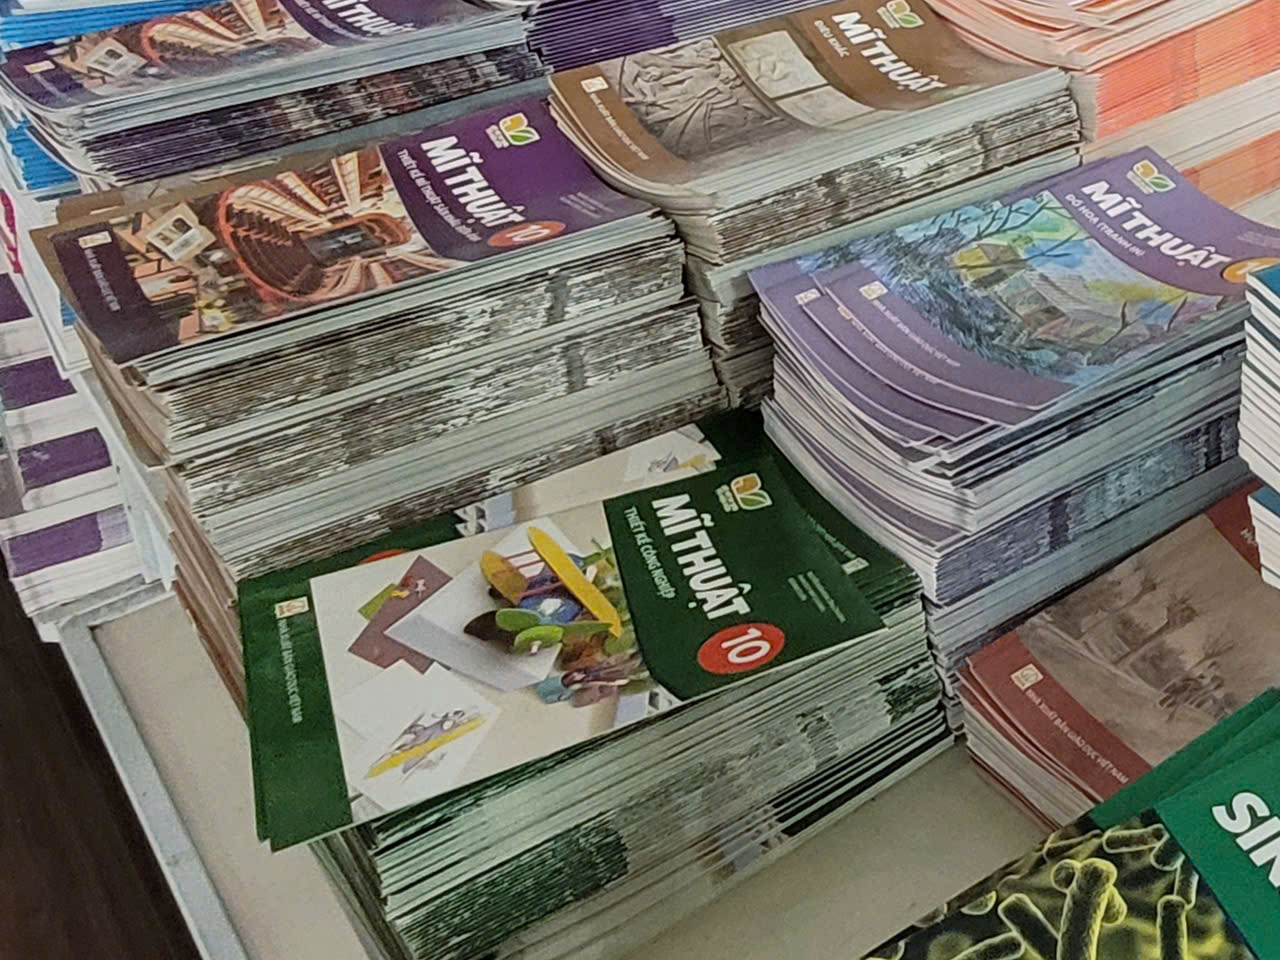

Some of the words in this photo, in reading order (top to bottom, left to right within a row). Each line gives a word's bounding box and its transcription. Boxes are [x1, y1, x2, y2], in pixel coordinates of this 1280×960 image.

[831, 11, 888, 45] MĨ
[860, 40, 948, 93] THUẬT
[420, 135, 484, 173] MĨ
[444, 165, 527, 228] THUẬT
[1081, 180, 1143, 218] MĨ
[1122, 210, 1233, 269] THUẬT
[622, 506, 647, 534] THIẾT
[639, 543, 661, 569] CÔNG
[652, 493, 715, 537] MĨ
[670, 529, 752, 621] THUẬT
[721, 627, 771, 664] 10
